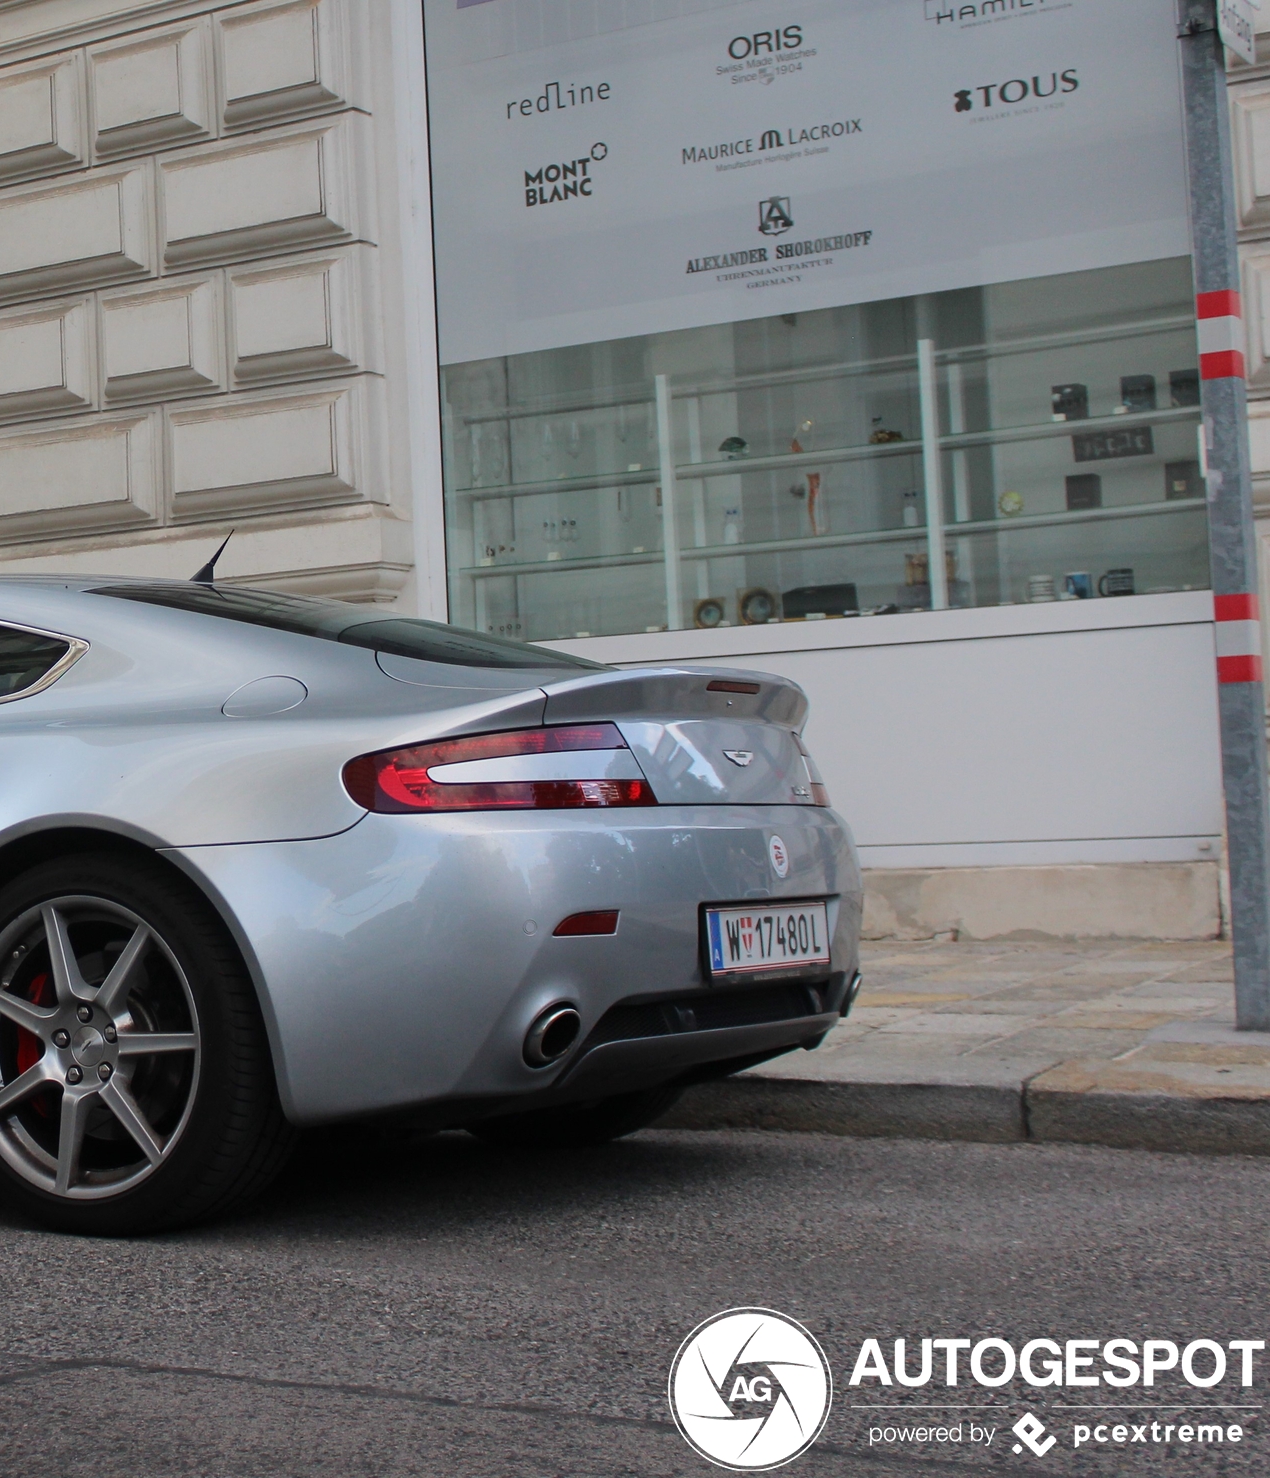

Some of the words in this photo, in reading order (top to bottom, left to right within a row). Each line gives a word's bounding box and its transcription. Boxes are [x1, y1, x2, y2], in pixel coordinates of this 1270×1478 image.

[728, 25, 803, 60] ORIS
[716, 64, 743, 75] Swiss
[747, 57, 773, 69] Made
[775, 48, 817, 62] Watches
[731, 73, 757, 84] Since
[775, 62, 803, 75] 1904
[976, 69, 1079, 107] TOUS
[525, 157, 591, 188] MONT
[525, 177, 592, 207] BLANC
[686, 248, 768, 274] ALEXANDER
[776, 230, 872, 260] SHOROKHOFF
[716, 257, 834, 282] UHRENMANUFAKTUR
[746, 275, 802, 289] GERMANY
[725, 919, 740, 962] W
[755, 913, 822, 959] 17480L
